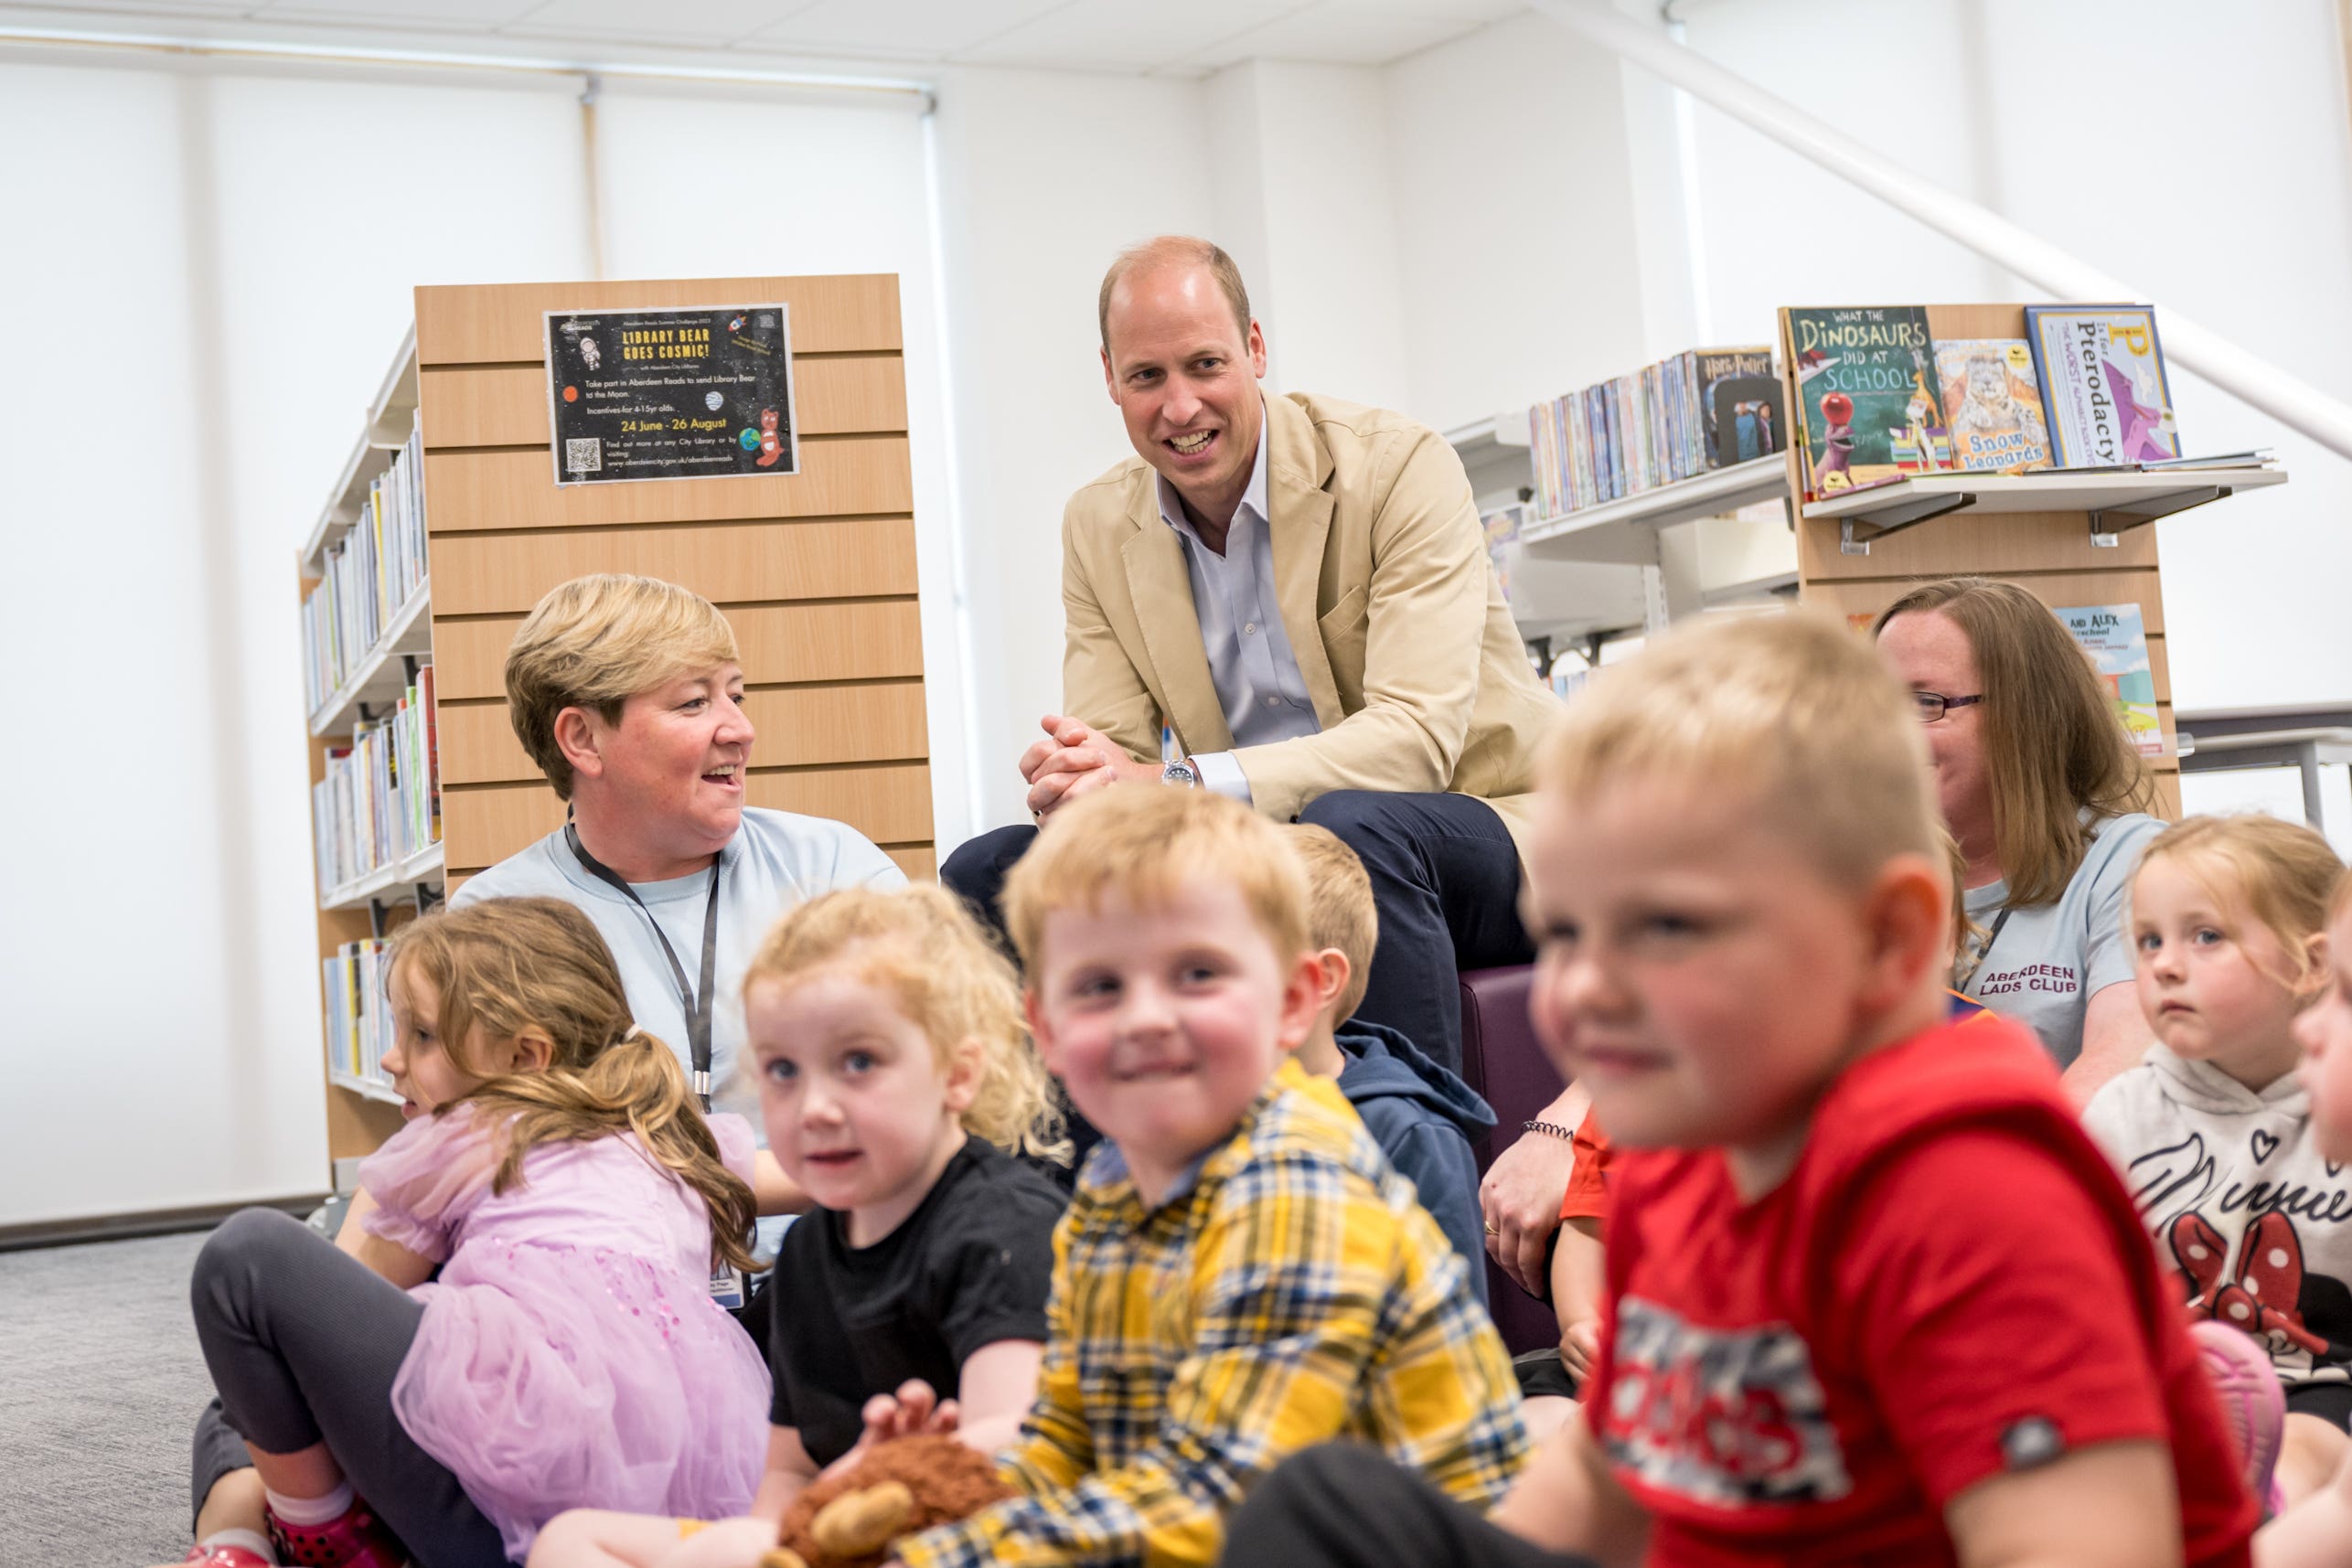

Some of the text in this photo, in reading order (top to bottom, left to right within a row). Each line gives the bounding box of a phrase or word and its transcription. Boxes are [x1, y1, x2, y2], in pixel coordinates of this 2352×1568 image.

[1833, 309, 1885, 323] WHAT THE
[622, 328, 710, 345] LIBRARY BEAR
[2107, 322, 2149, 357] P
[624, 344, 710, 360] GOES COSMIC!
[2100, 337, 2110, 356] for
[1843, 350, 1888, 366] DID AT
[2065, 343, 2081, 384] WORST
[585, 379, 602, 388] Take
[604, 380, 618, 389] part
[628, 378, 662, 386] Aberdeen
[664, 377, 685, 385] Reads
[696, 375, 711, 383] send
[713, 375, 737, 383] Library
[739, 373, 755, 382] Bear
[1823, 367, 1918, 391] SCHOOL
[607, 390, 629, 399] Moon.
[2077, 322, 2116, 464] Pterodacty
[587, 406, 621, 414] Incentives
[622, 405, 632, 413] for
[621, 421, 636, 432] 24
[639, 420, 663, 432] June
[672, 419, 688, 430] 26
[690, 418, 727, 432] August
[694, 437, 715, 445] Library
[729, 435, 737, 444] by
[1970, 433, 2024, 453] Snow
[1963, 446, 2044, 470] Leopards
[2070, 613, 2119, 628] AND ALEX
[2072, 626, 2110, 637] reschool
[1984, 965, 2074, 983] ABERDEEN
[1979, 978, 2077, 996] LADS CLUB
